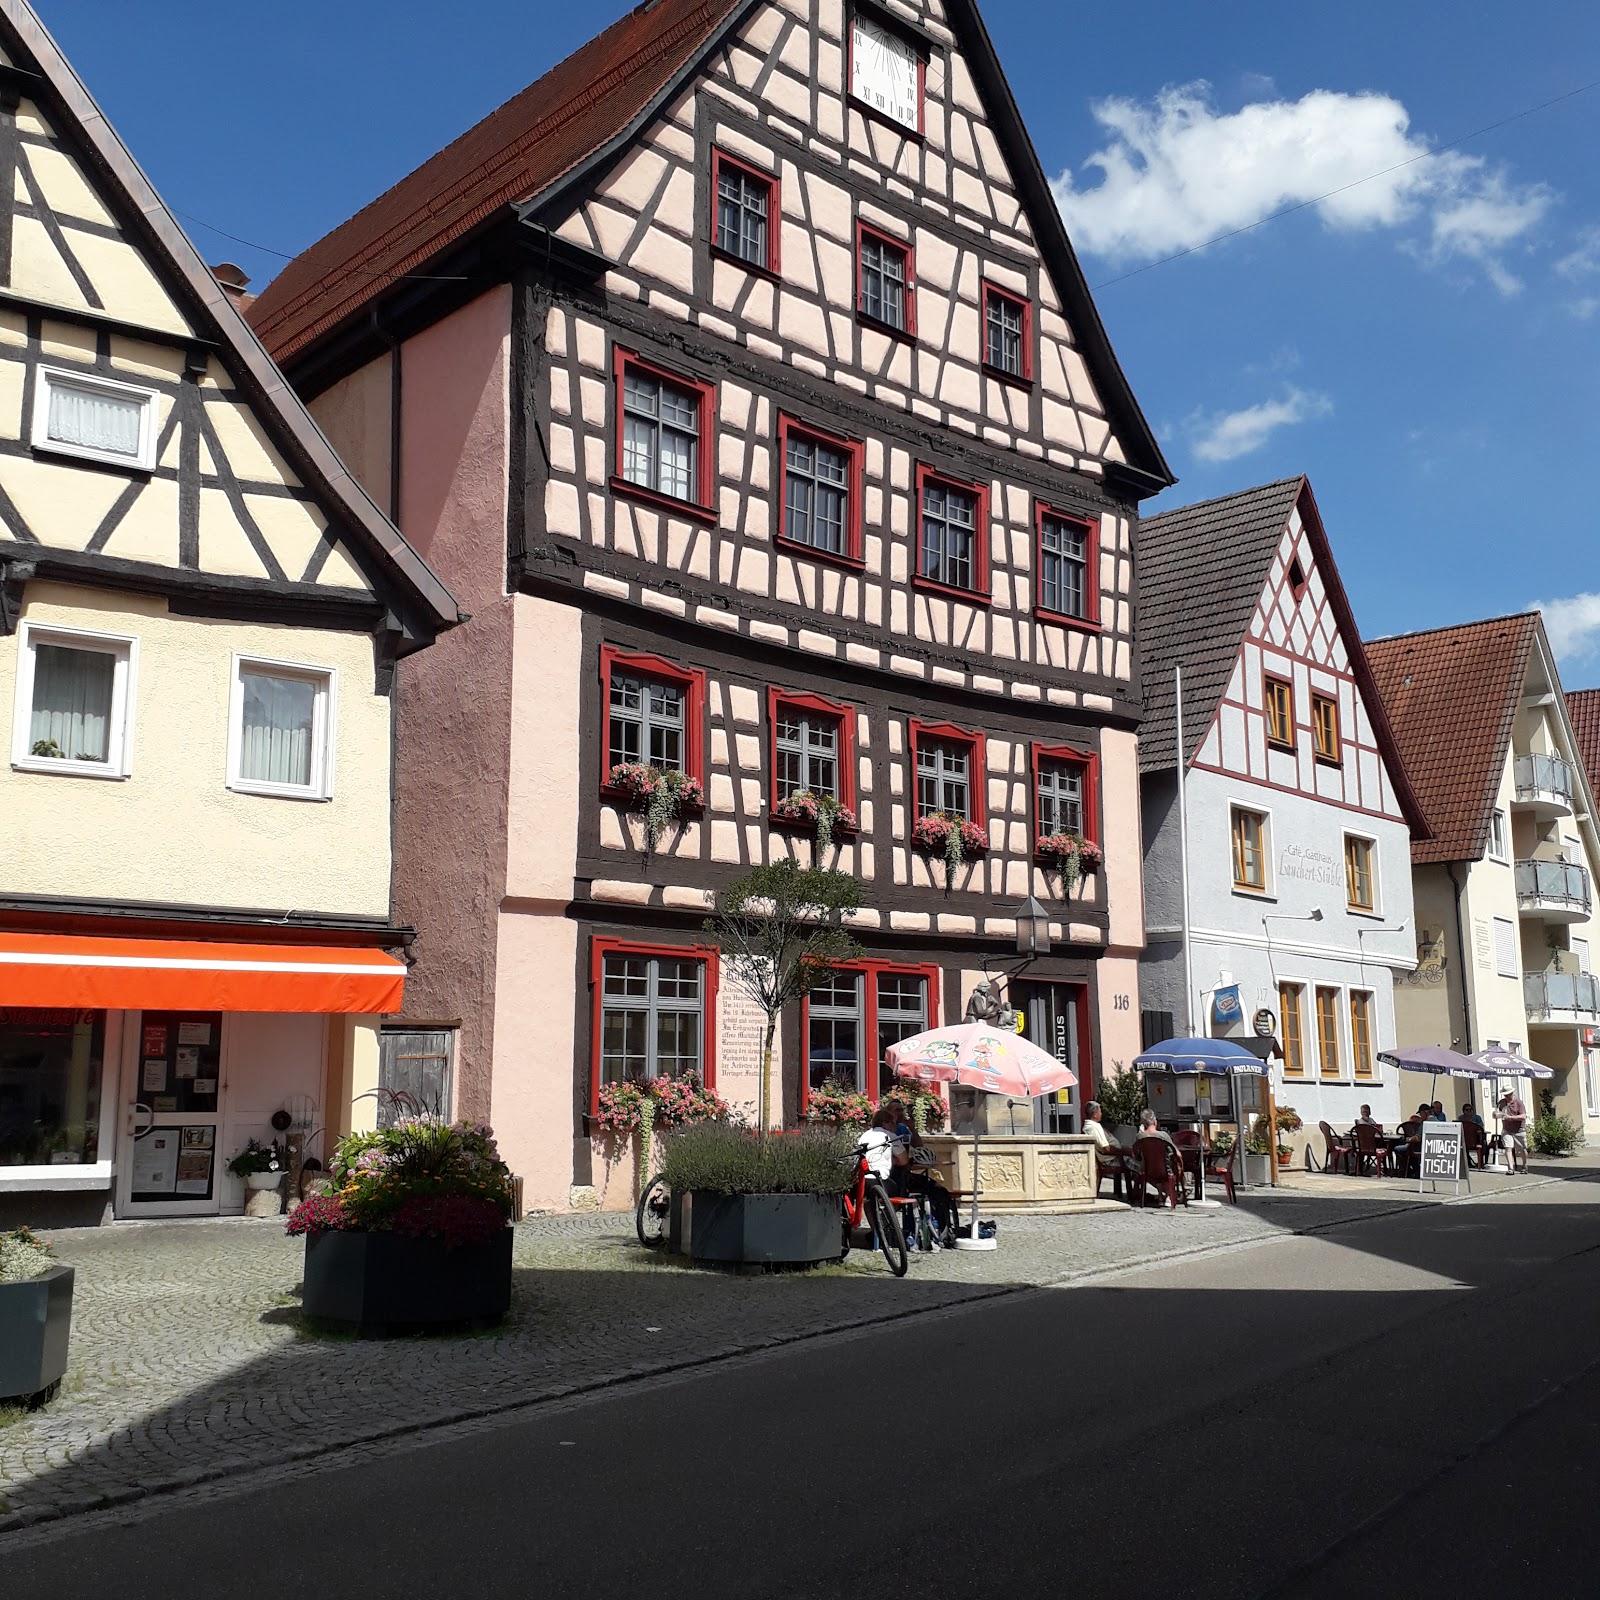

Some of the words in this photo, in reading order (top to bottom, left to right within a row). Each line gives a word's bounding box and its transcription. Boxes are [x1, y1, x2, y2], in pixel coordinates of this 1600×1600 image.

[855, 32, 862, 47] IX
[855, 61, 861, 75] X
[863, 85, 870, 101] XI
[876, 92, 885, 109] XII
[1257, 986, 1268, 1001] 117
[1113, 994, 1130, 1011] 116
[1136, 1061, 1166, 1070] PAULANER
[1233, 1065, 1263, 1073] PAULANER
[1425, 1139, 1457, 1155] MITTAGS
[1424, 1158, 1455, 1174] TISCH
